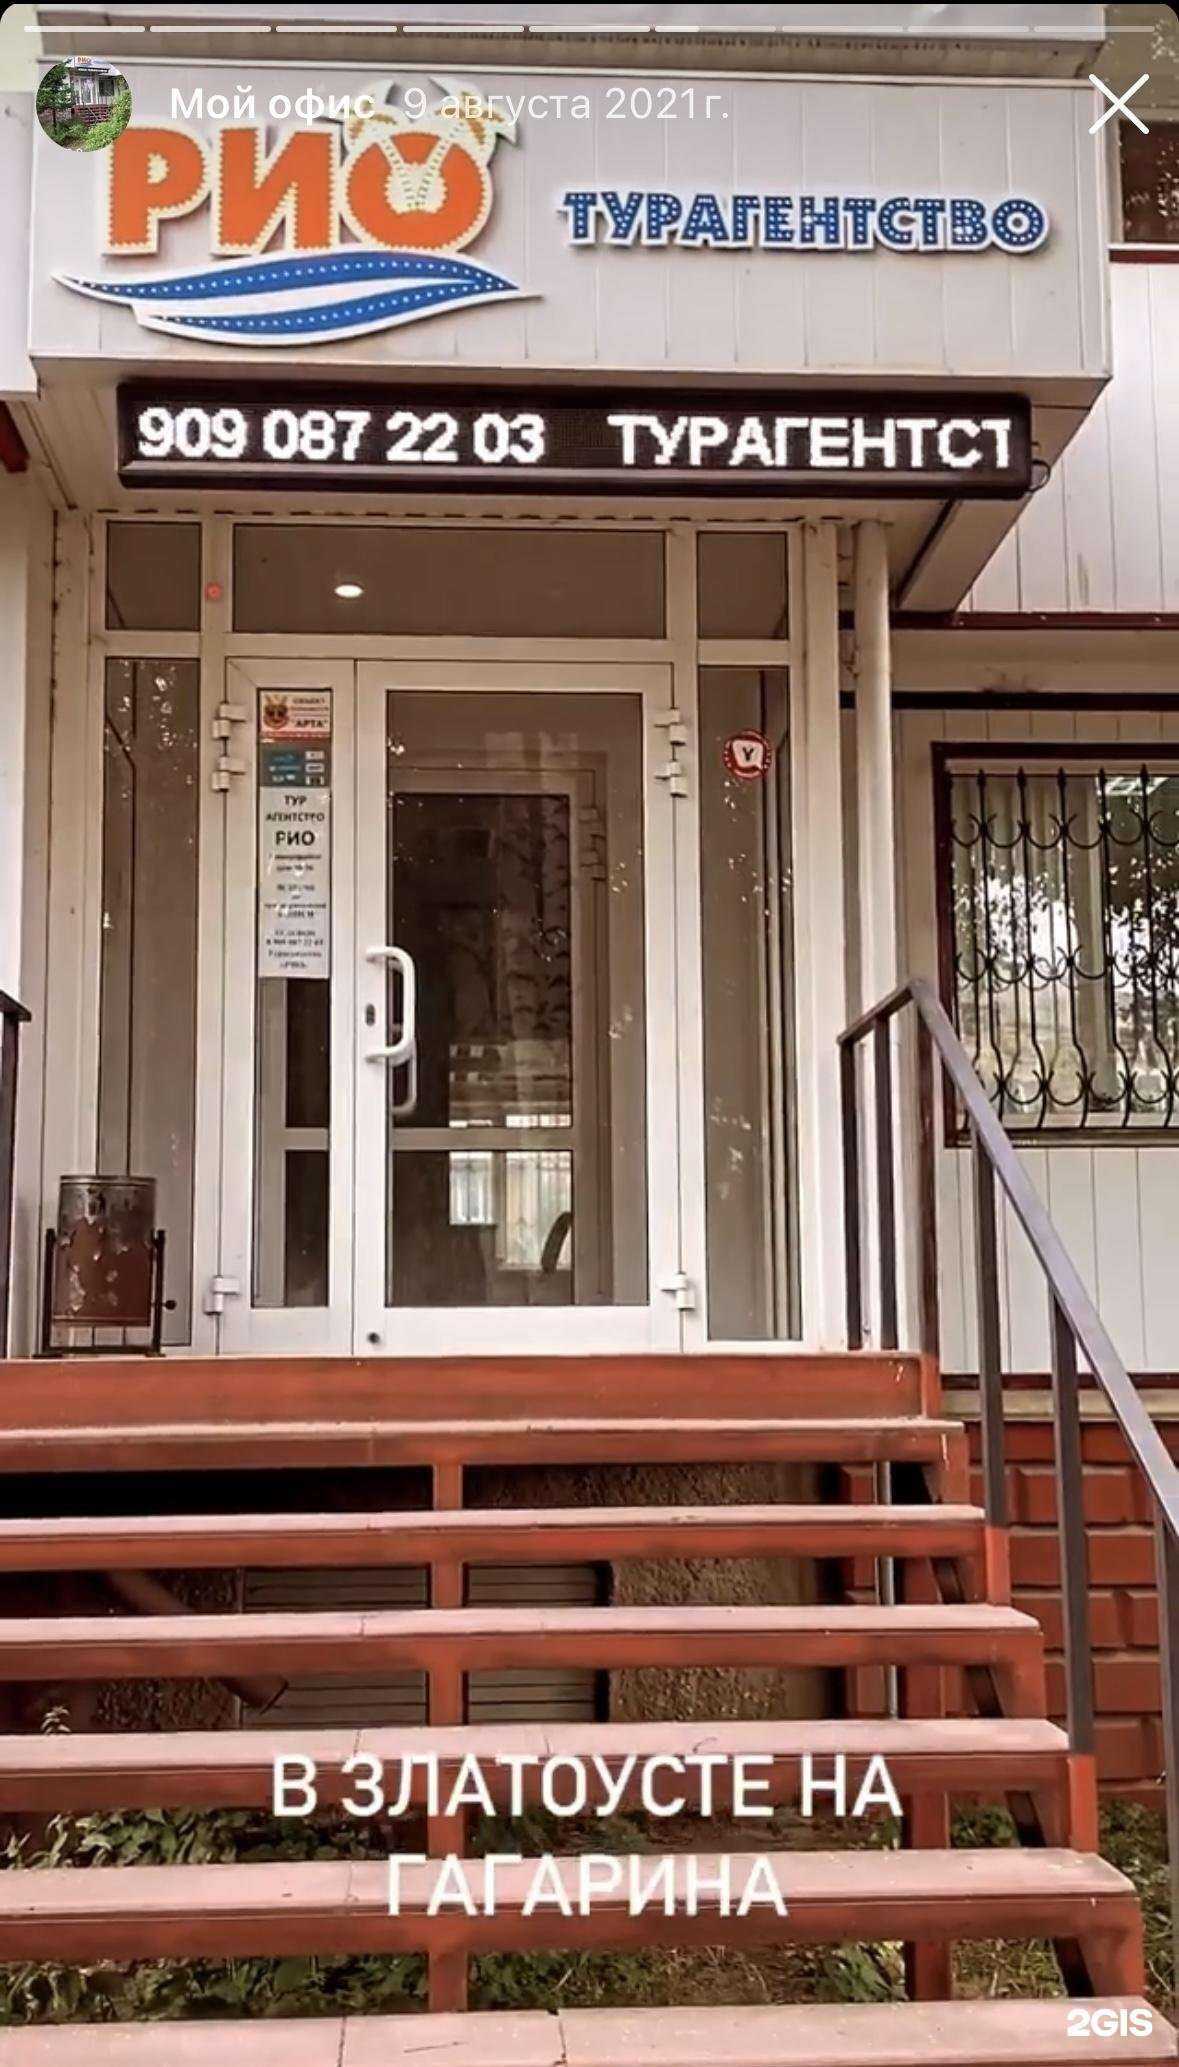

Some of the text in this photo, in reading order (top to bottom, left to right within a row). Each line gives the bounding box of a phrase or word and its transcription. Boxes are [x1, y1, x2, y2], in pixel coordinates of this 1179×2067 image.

[105, 125, 490, 254] РИО
[560, 190, 1050, 252] ТУРАГЕНТСТВО
[138, 407, 1012, 469] 909 087 22 03 ТУРАГЕНТСТ
[275, 830, 316, 846] РИО
